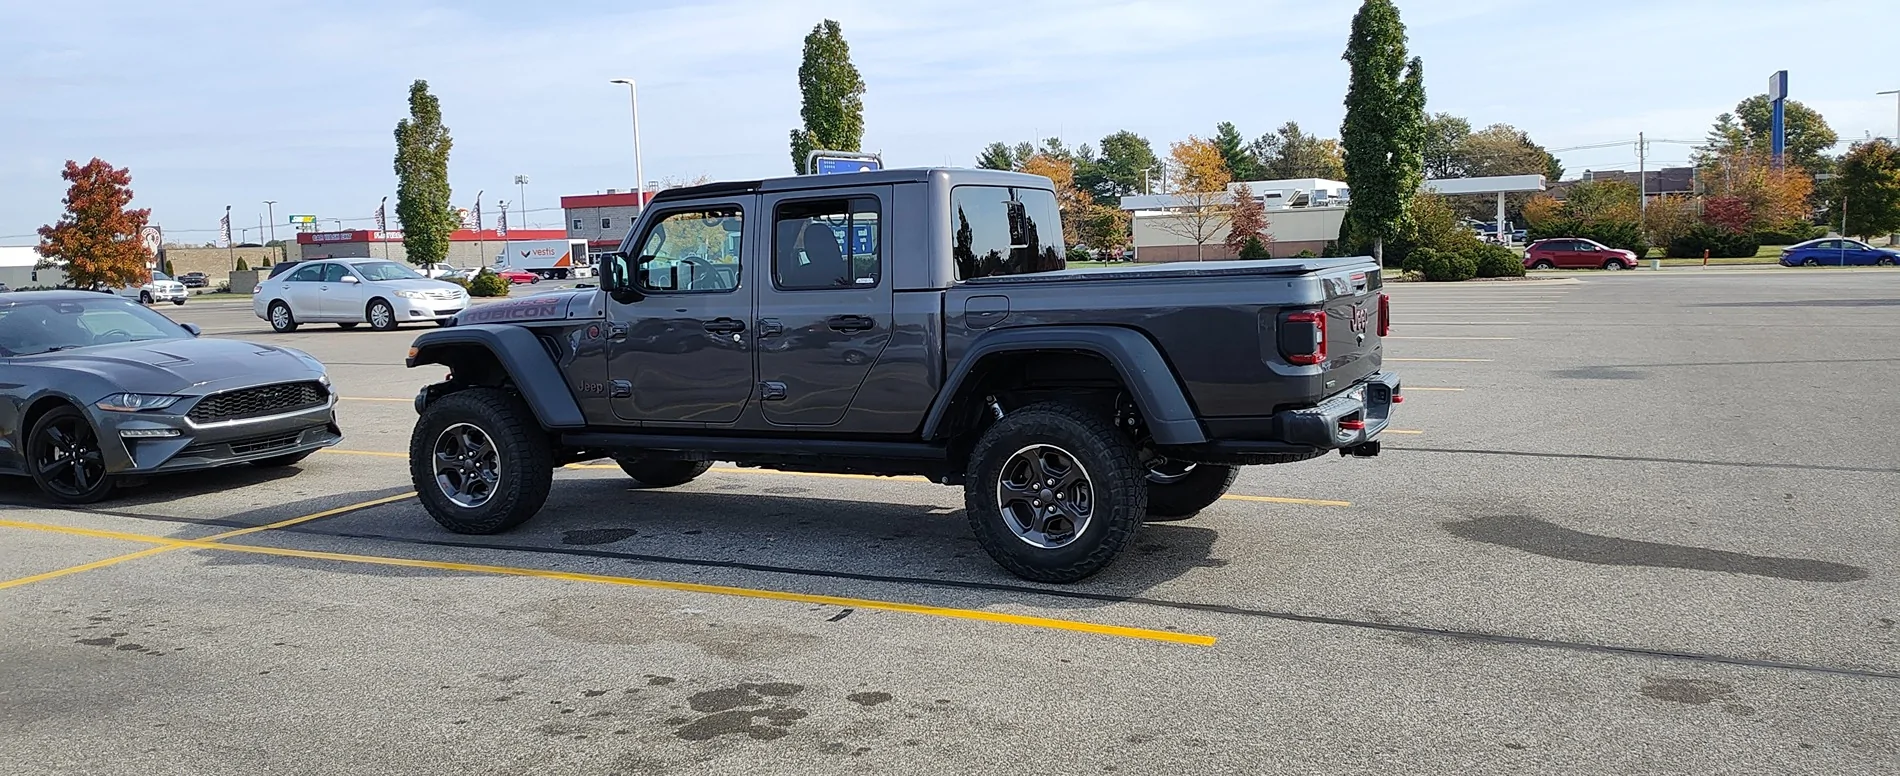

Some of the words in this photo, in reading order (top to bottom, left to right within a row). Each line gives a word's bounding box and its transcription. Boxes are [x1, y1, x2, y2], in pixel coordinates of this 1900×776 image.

[532, 246, 555, 255] vestis
[465, 305, 556, 321] RUBICON
[1350, 304, 1368, 333] Jeep
[578, 380, 604, 394] Jeep
